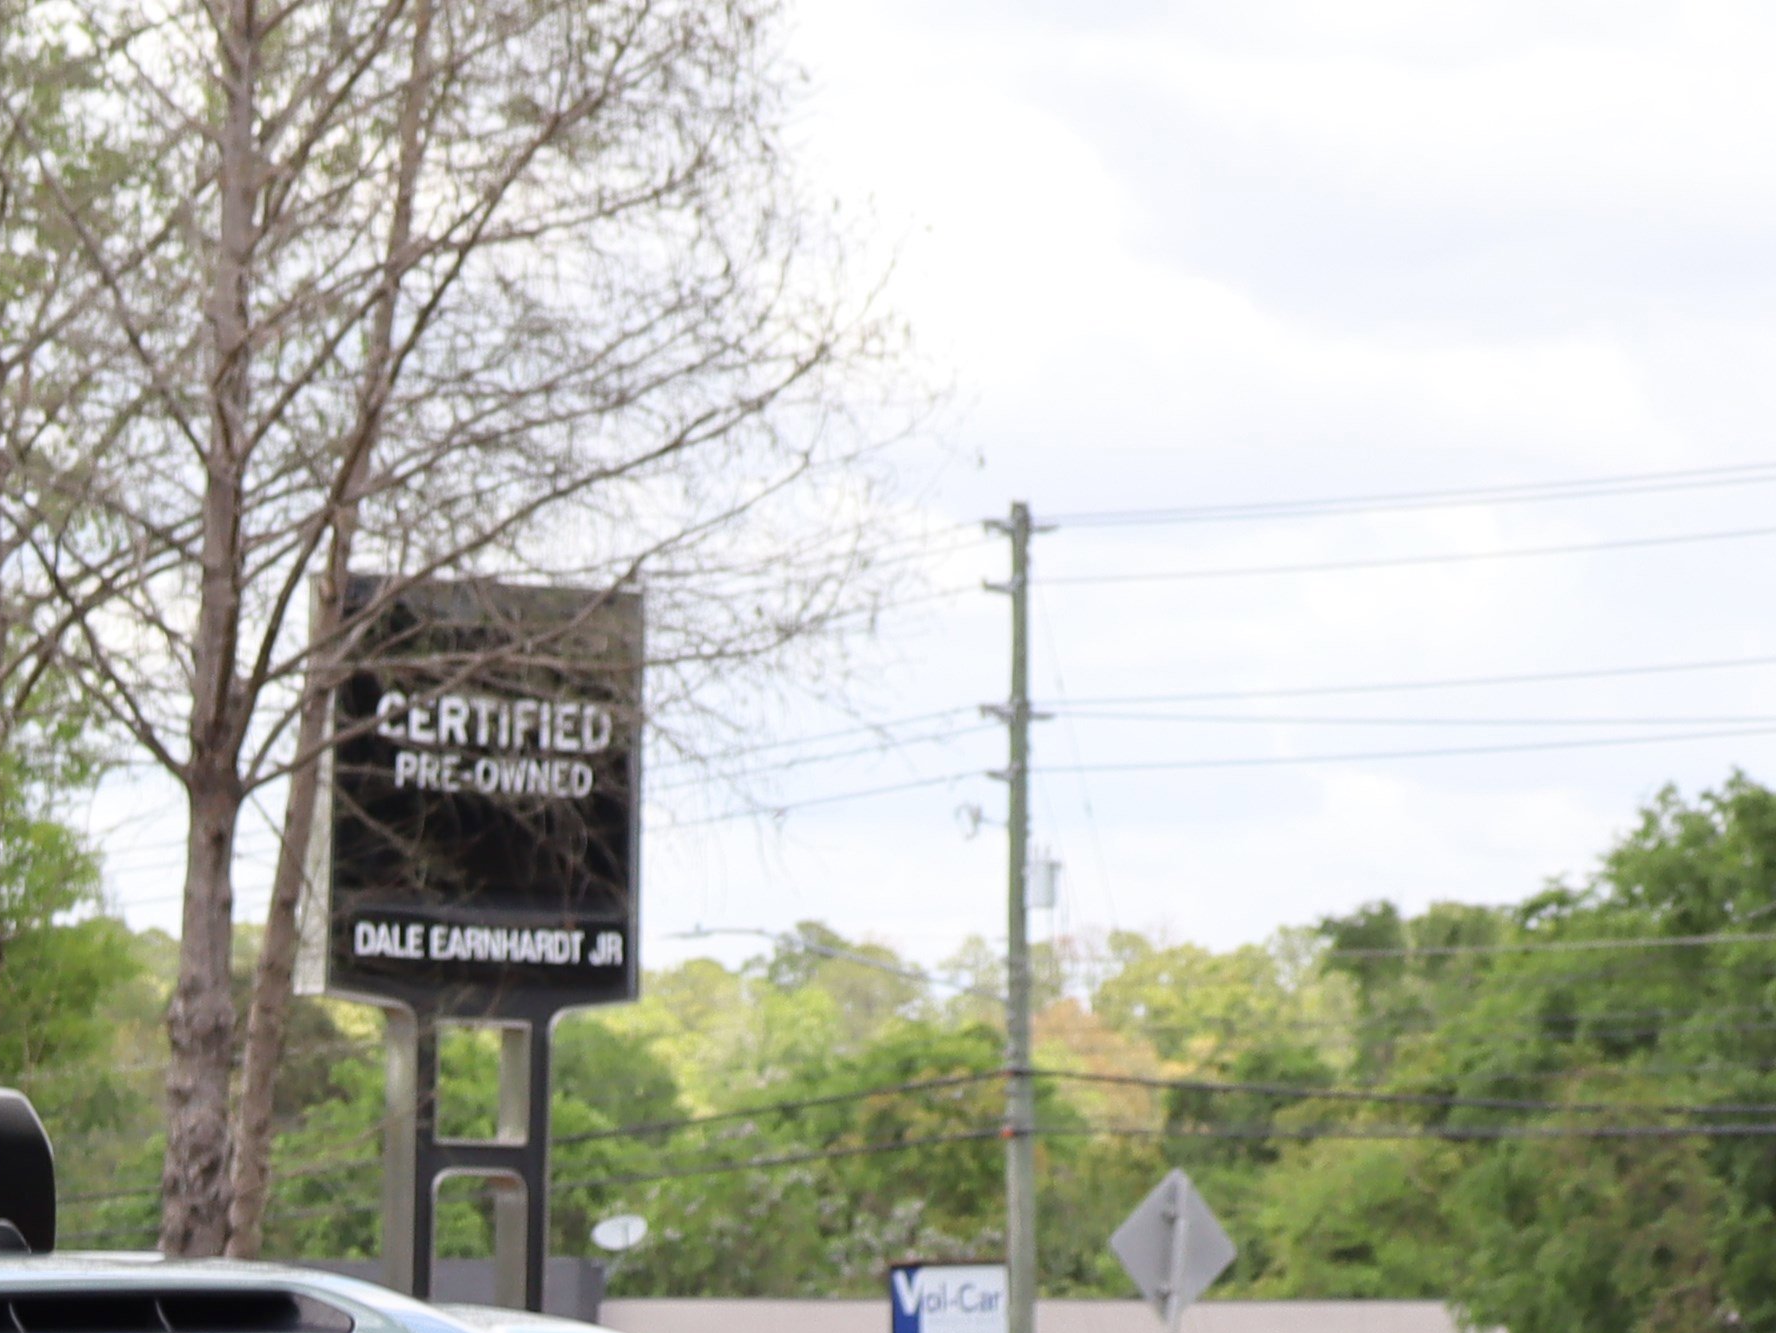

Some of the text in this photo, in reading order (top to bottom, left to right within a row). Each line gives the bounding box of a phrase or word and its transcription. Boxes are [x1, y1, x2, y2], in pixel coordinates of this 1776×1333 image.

[376, 690, 613, 754] CERTIFIED
[395, 750, 594, 799] PRE-OWNED
[354, 921, 624, 966] DALE EARNHARDT JR
